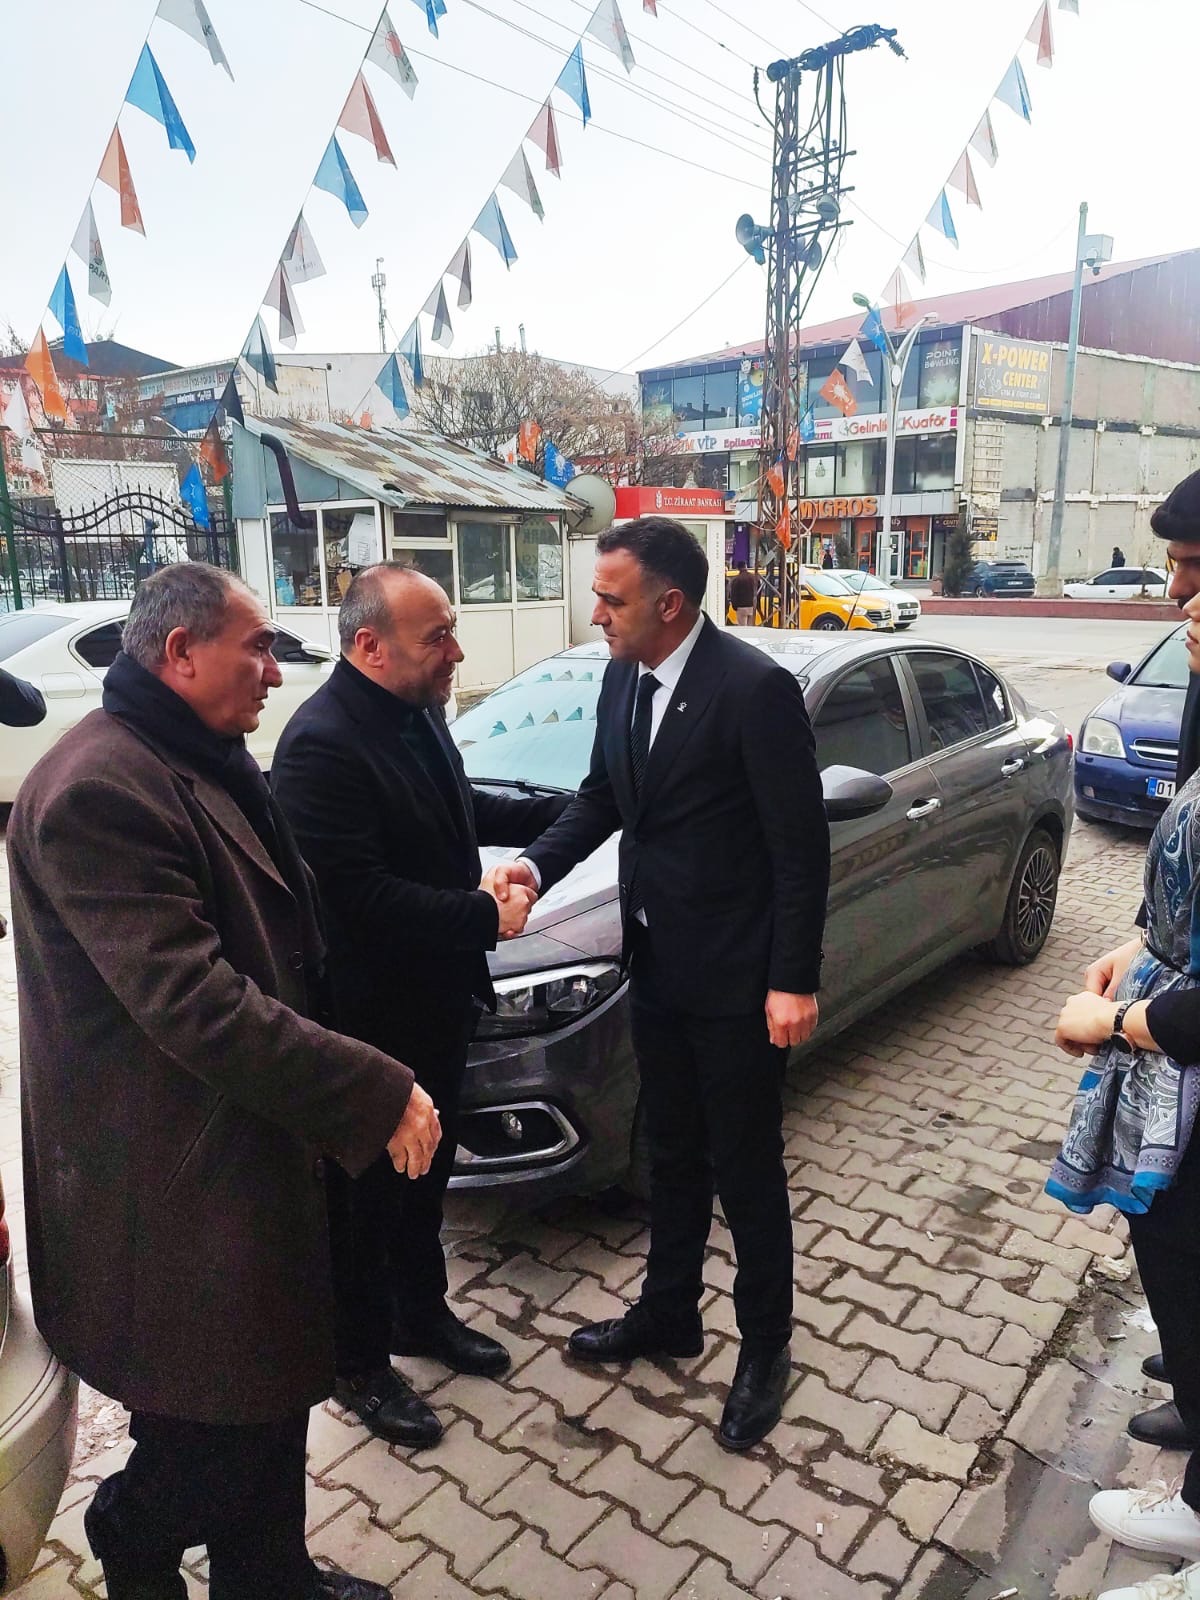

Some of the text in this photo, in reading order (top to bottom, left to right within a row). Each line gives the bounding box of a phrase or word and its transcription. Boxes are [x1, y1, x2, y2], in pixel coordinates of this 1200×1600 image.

[926, 348, 959, 359] POINT
[981, 342, 1048, 372] X-POWER
[924, 357, 960, 369] BOWLING
[1002, 371, 1038, 388] CENTER
[903, 413, 947, 430] Kuaför
[1157, 782, 1172, 796] 01
